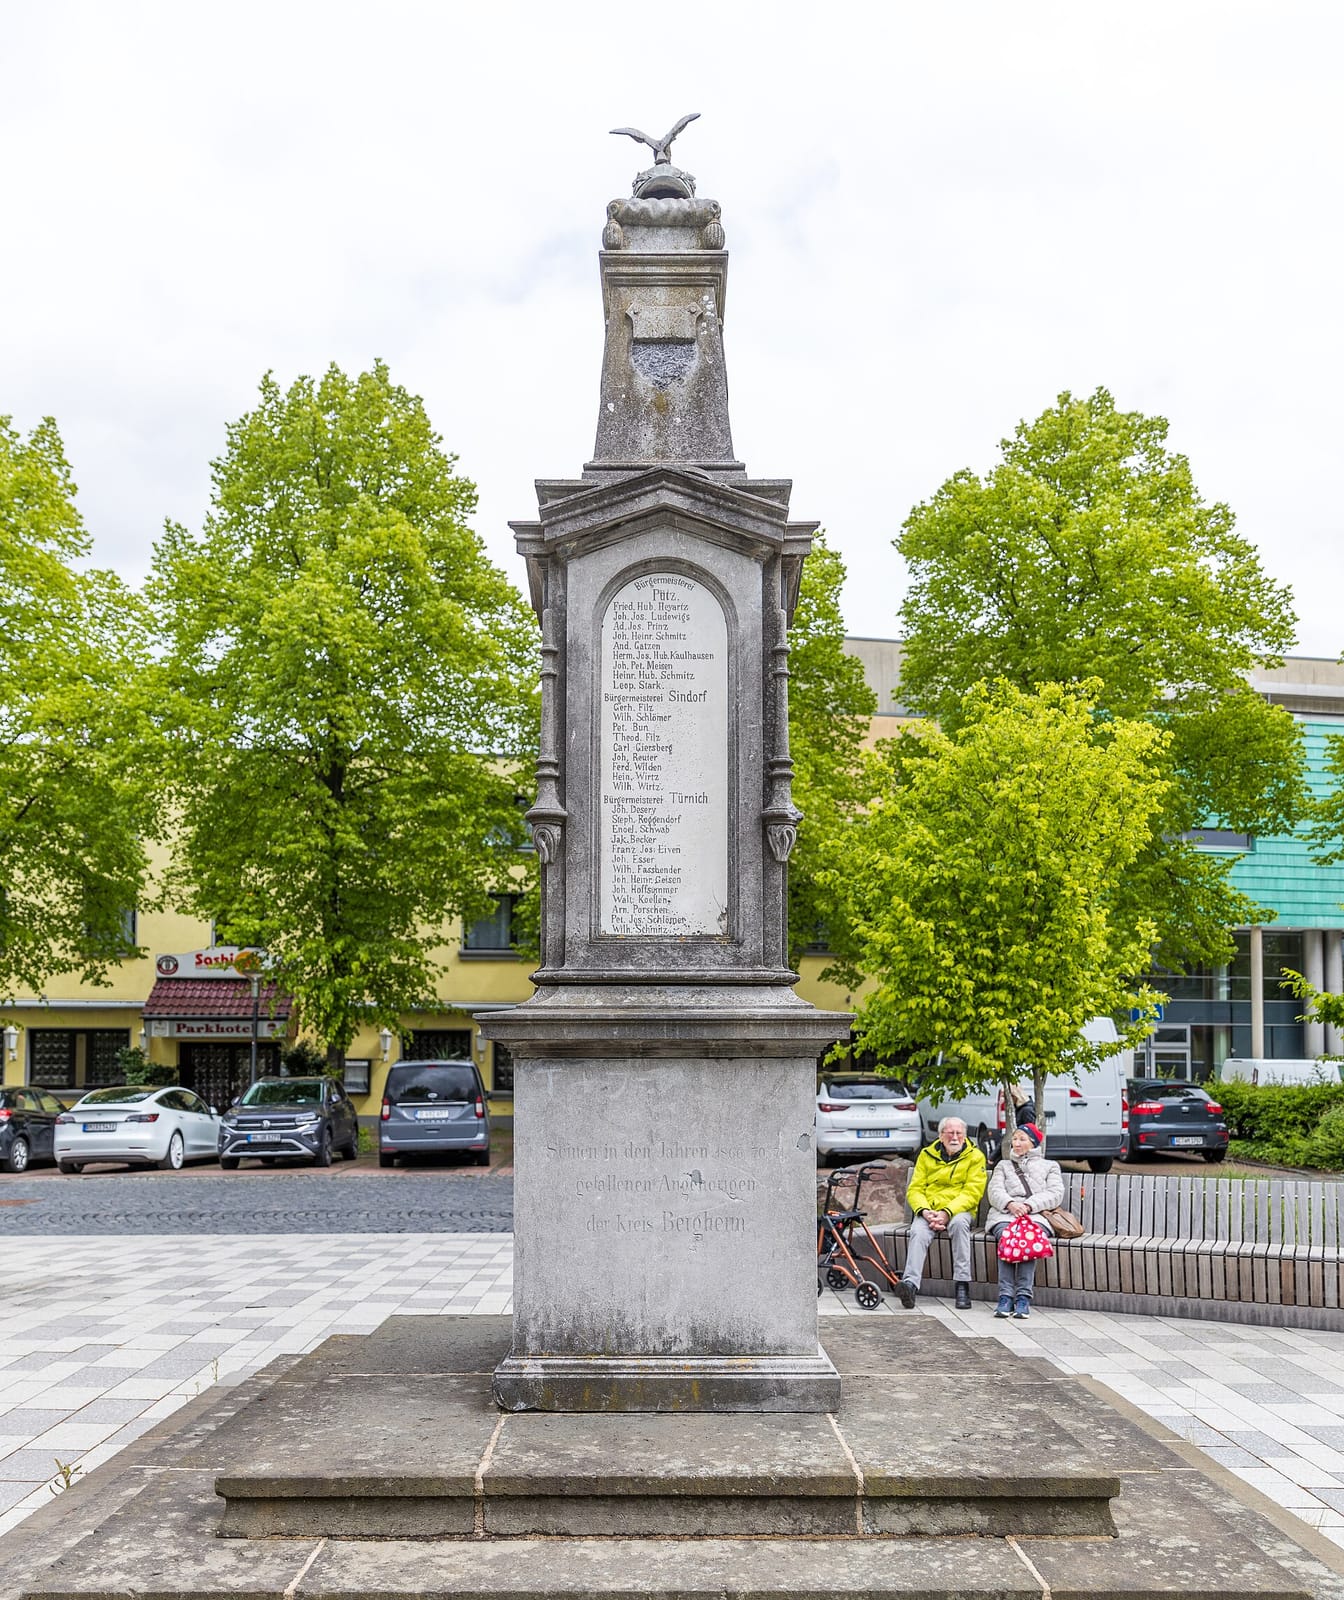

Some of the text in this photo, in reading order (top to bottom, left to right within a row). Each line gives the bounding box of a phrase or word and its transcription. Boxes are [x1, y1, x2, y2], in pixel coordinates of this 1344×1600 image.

[634, 577, 696, 591] Bürgermeisterei
[653, 589, 680, 601] Pütz.
[613, 602, 635, 610] Fried.
[637, 602, 655, 610] Hub.
[613, 612, 690, 623] Joh. Jos. Ludewigs
[613, 622, 668, 630] Ad. Jos. Prinz
[613, 632, 687, 640] Joh. Heinr. Schmitz
[613, 642, 631, 650] And.
[613, 651, 714, 660] Herm. Jos. Hub. Kaulhausen
[613, 661, 673, 670] Joh. Pet. Meisen
[613, 671, 635, 680] Heinr.
[639, 671, 657, 680] Hub.
[613, 681, 664, 691] Leop. Stark.
[604, 690, 707, 704] Bürgermeisterei Sindorf
[613, 703, 635, 711] Gerh.
[613, 713, 671, 721] Wilh. Schlömer
[613, 723, 649, 731] Pet. Bun
[645, 733, 661, 742] Filz
[613, 743, 629, 752] Carl
[612, 753, 658, 761] Joh. Reuter
[612, 762, 662, 771] Ferd. Wilden
[636, 772, 659, 781] Wirtz
[613, 782, 634, 791] Wilh.
[604, 792, 708, 806] Bürgermeisterei Türnich
[612, 805, 628, 814] Joh.
[612, 815, 635, 825] Steph.
[640, 825, 670, 833] Schwab
[611, 835, 656, 844] Jak. Becker
[612, 845, 635, 854] Franz
[612, 855, 655, 864] Joh. Esser
[613, 865, 634, 874] Wilh.
[612, 875, 629, 884] Joh.
[612, 885, 629, 894] Joh.
[612, 905, 629, 913] Arn.
[611, 915, 626, 923] Pet.
[604, 1144, 617, 1159] in
[625, 1142, 651, 1158] den
[658, 1142, 708, 1159] Jahren
[576, 1174, 651, 1196] gefallenen
[586, 1214, 610, 1232] der
[662, 1210, 747, 1240] Bergheim
